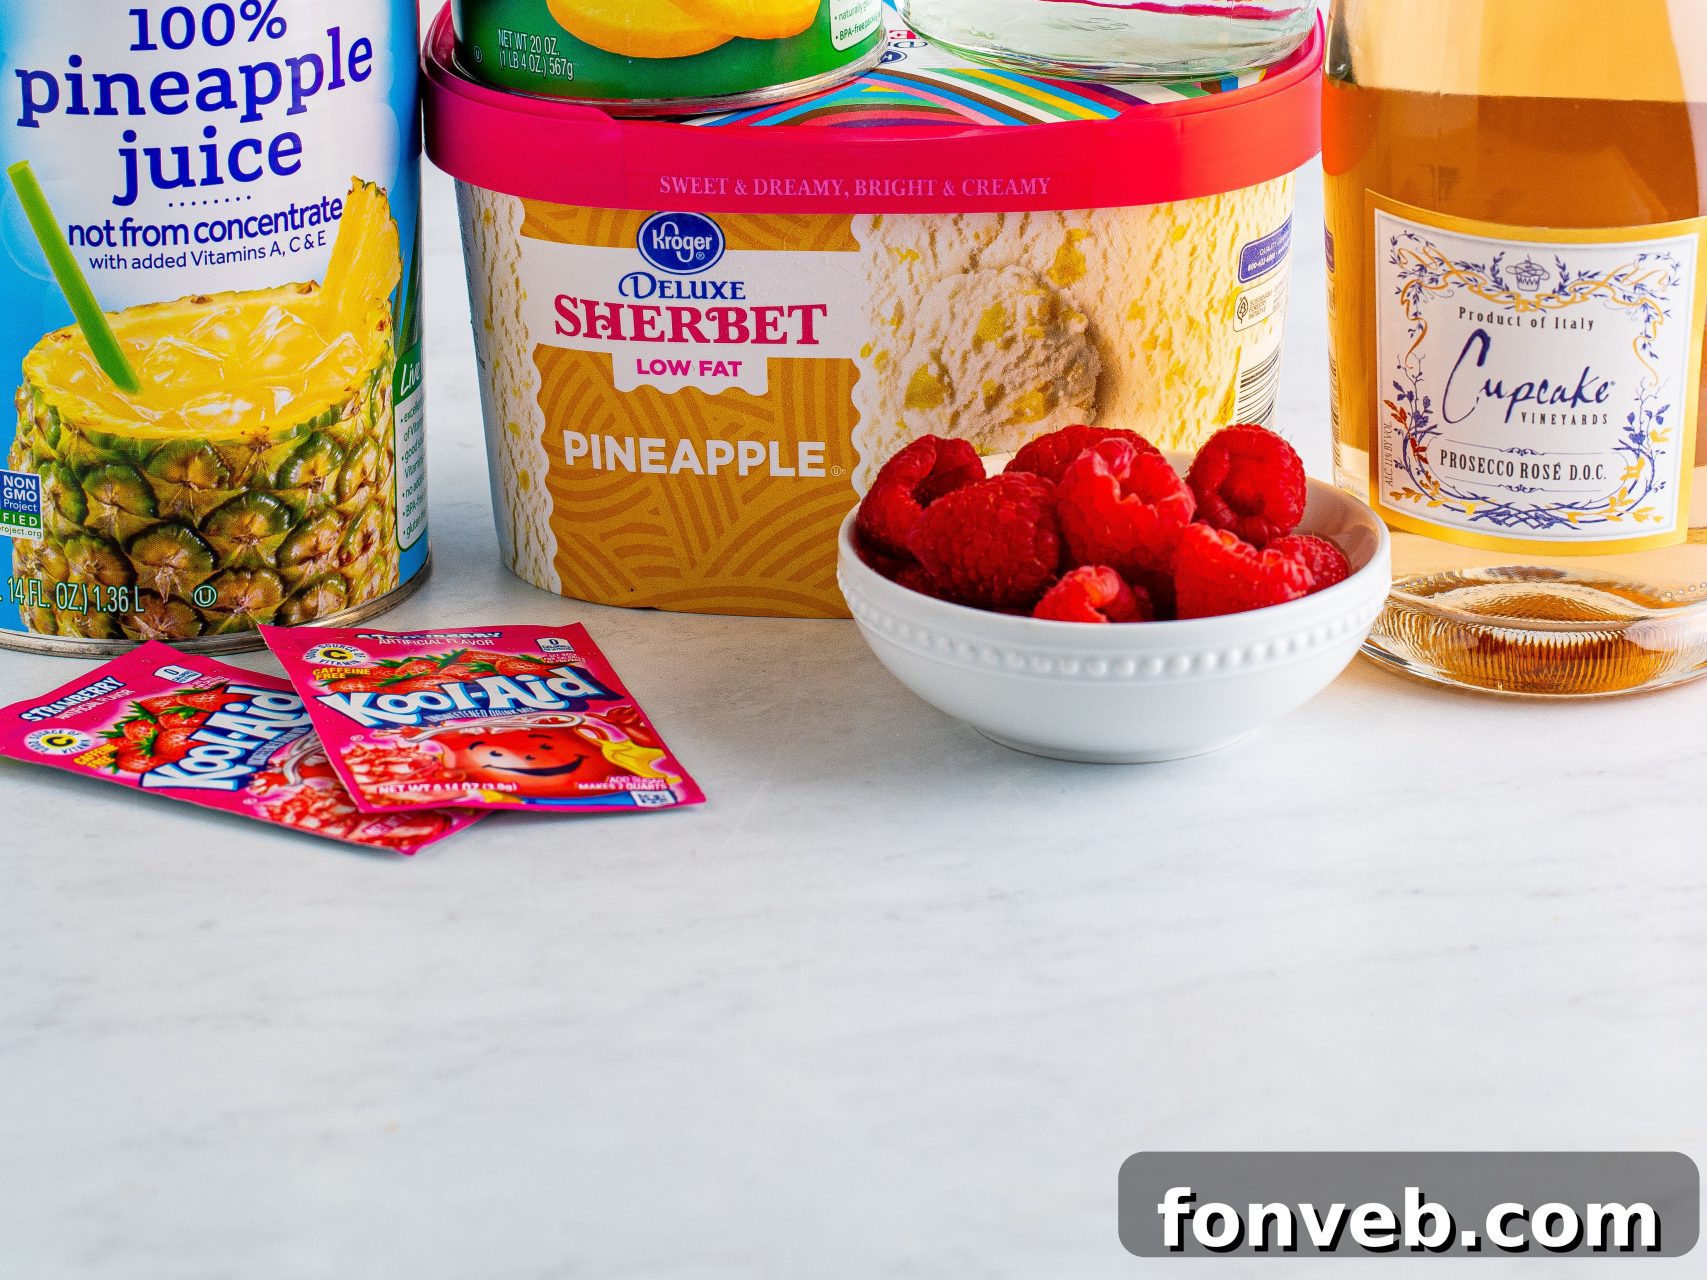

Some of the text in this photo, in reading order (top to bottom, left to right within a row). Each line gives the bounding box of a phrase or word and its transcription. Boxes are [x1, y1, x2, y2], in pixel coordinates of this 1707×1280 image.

[498, 28, 560, 56] NET WT 20 OZ.
[840, 23, 865, 40] BPA-free
[15, 26, 373, 128] pineapple
[508, 50, 519, 69] LB
[521, 53, 527, 70] 4
[528, 54, 547, 78] OZ.)
[549, 57, 574, 80] 567g
[112, 125, 303, 206] juice
[659, 175, 1051, 199] SWEET & DREAMY, BRIGHT & CREAMY
[68, 195, 343, 248] not from concentrate
[89, 230, 327, 270] with added Vitamins A, C & E
[651, 220, 714, 263] Kroger
[618, 271, 747, 301] DELUXE
[553, 294, 828, 345] SHERBET
[1459, 306, 1595, 332] Product of Italy
[400, 361, 421, 397] Live
[636, 358, 743, 377] LOW FAT
[1442, 328, 1611, 424] Cupcake
[1521, 411, 1608, 426] VINEYARDS
[563, 430, 827, 478] PINEAPPLE
[1440, 449, 1607, 481] PROSECCO ROSÉ D.O.C.
[3, 474, 36, 490] NON
[3, 487, 38, 503] GMO
[3, 499, 38, 512] Project
[7, 577, 145, 614] 14 FL. OZ.) 1.36 L
[312, 667, 371, 676] CAFFEINE
[315, 672, 347, 680] FREE
[19, 676, 126, 722] STRAWBERRY
[316, 666, 602, 727] Kool-Aid
[141, 685, 313, 791] Kool-Aid
